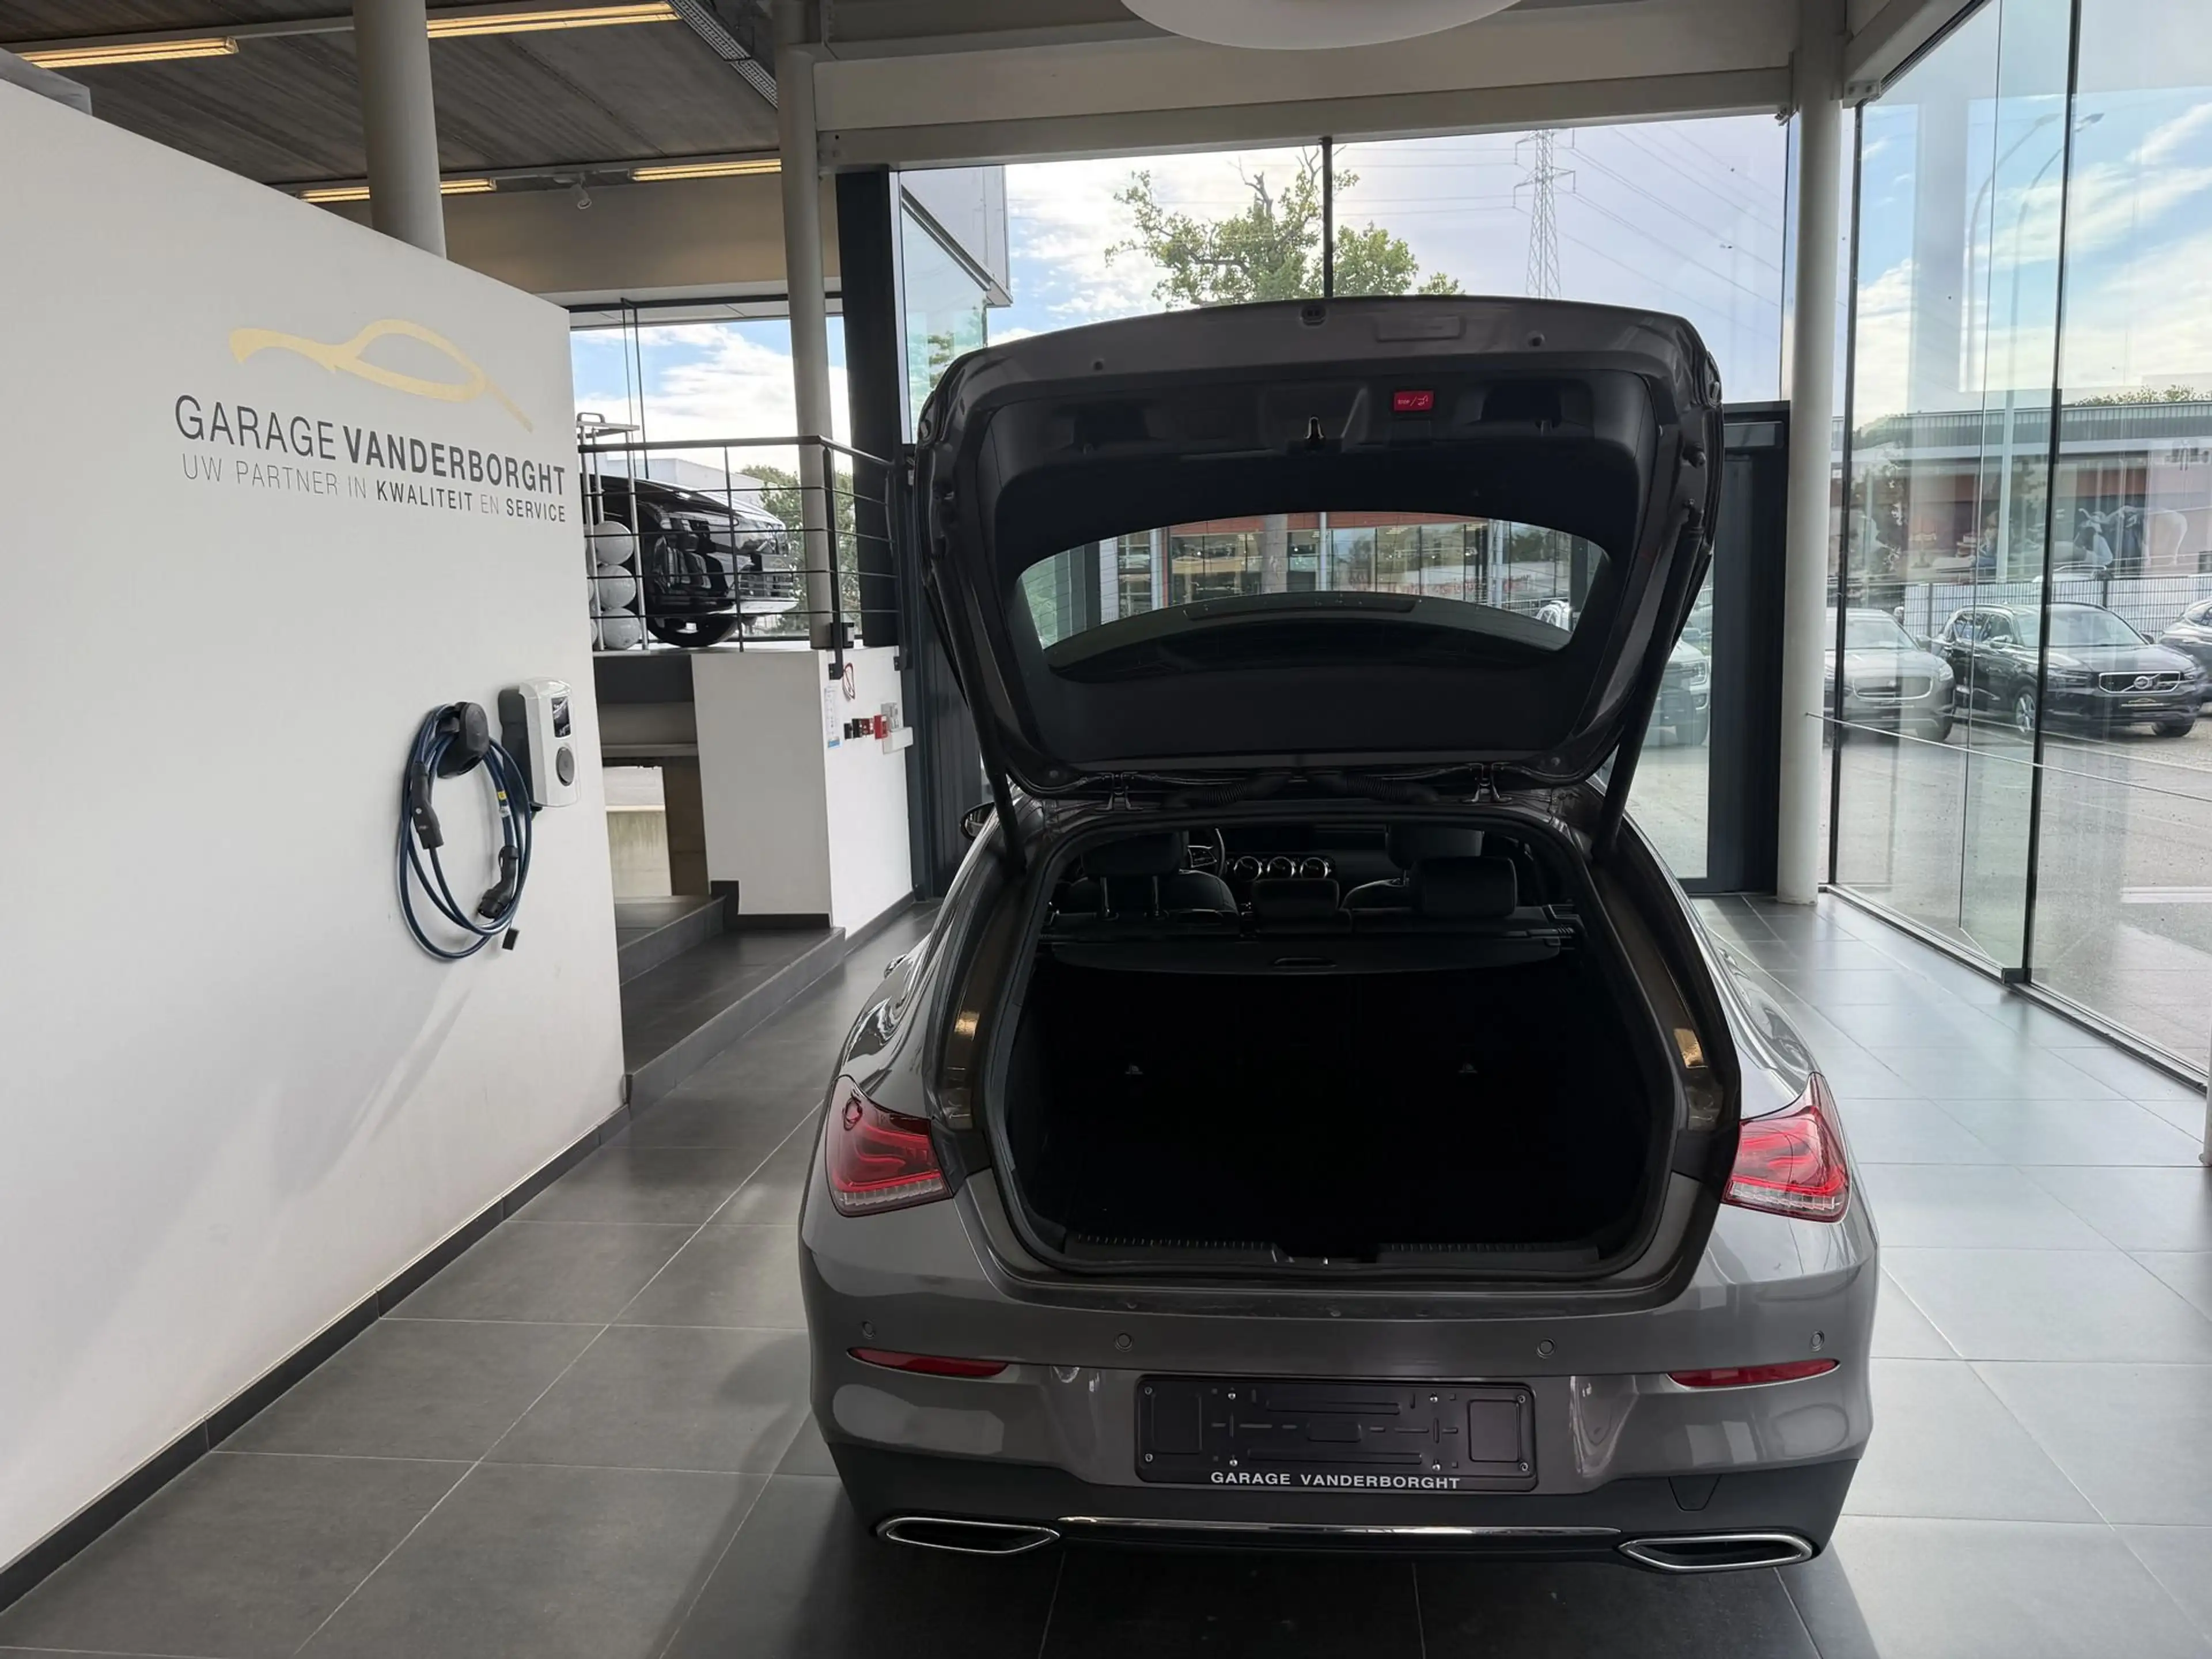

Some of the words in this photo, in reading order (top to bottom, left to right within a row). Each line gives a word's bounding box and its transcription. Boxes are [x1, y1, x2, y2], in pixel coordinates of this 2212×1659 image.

[175, 395, 336, 461] GARAGE
[342, 425, 566, 496] VANDERBORGHT
[182, 453, 222, 482] UW
[236, 460, 338, 496] PARTNER
[348, 475, 366, 499] IN
[376, 479, 473, 512] KWALITEIT
[480, 494, 499, 515] EN
[506, 497, 566, 523] SERVICE
[1210, 1471, 1291, 1486] GARAGE
[1300, 1474, 1460, 1490] VANDERBORGHT
